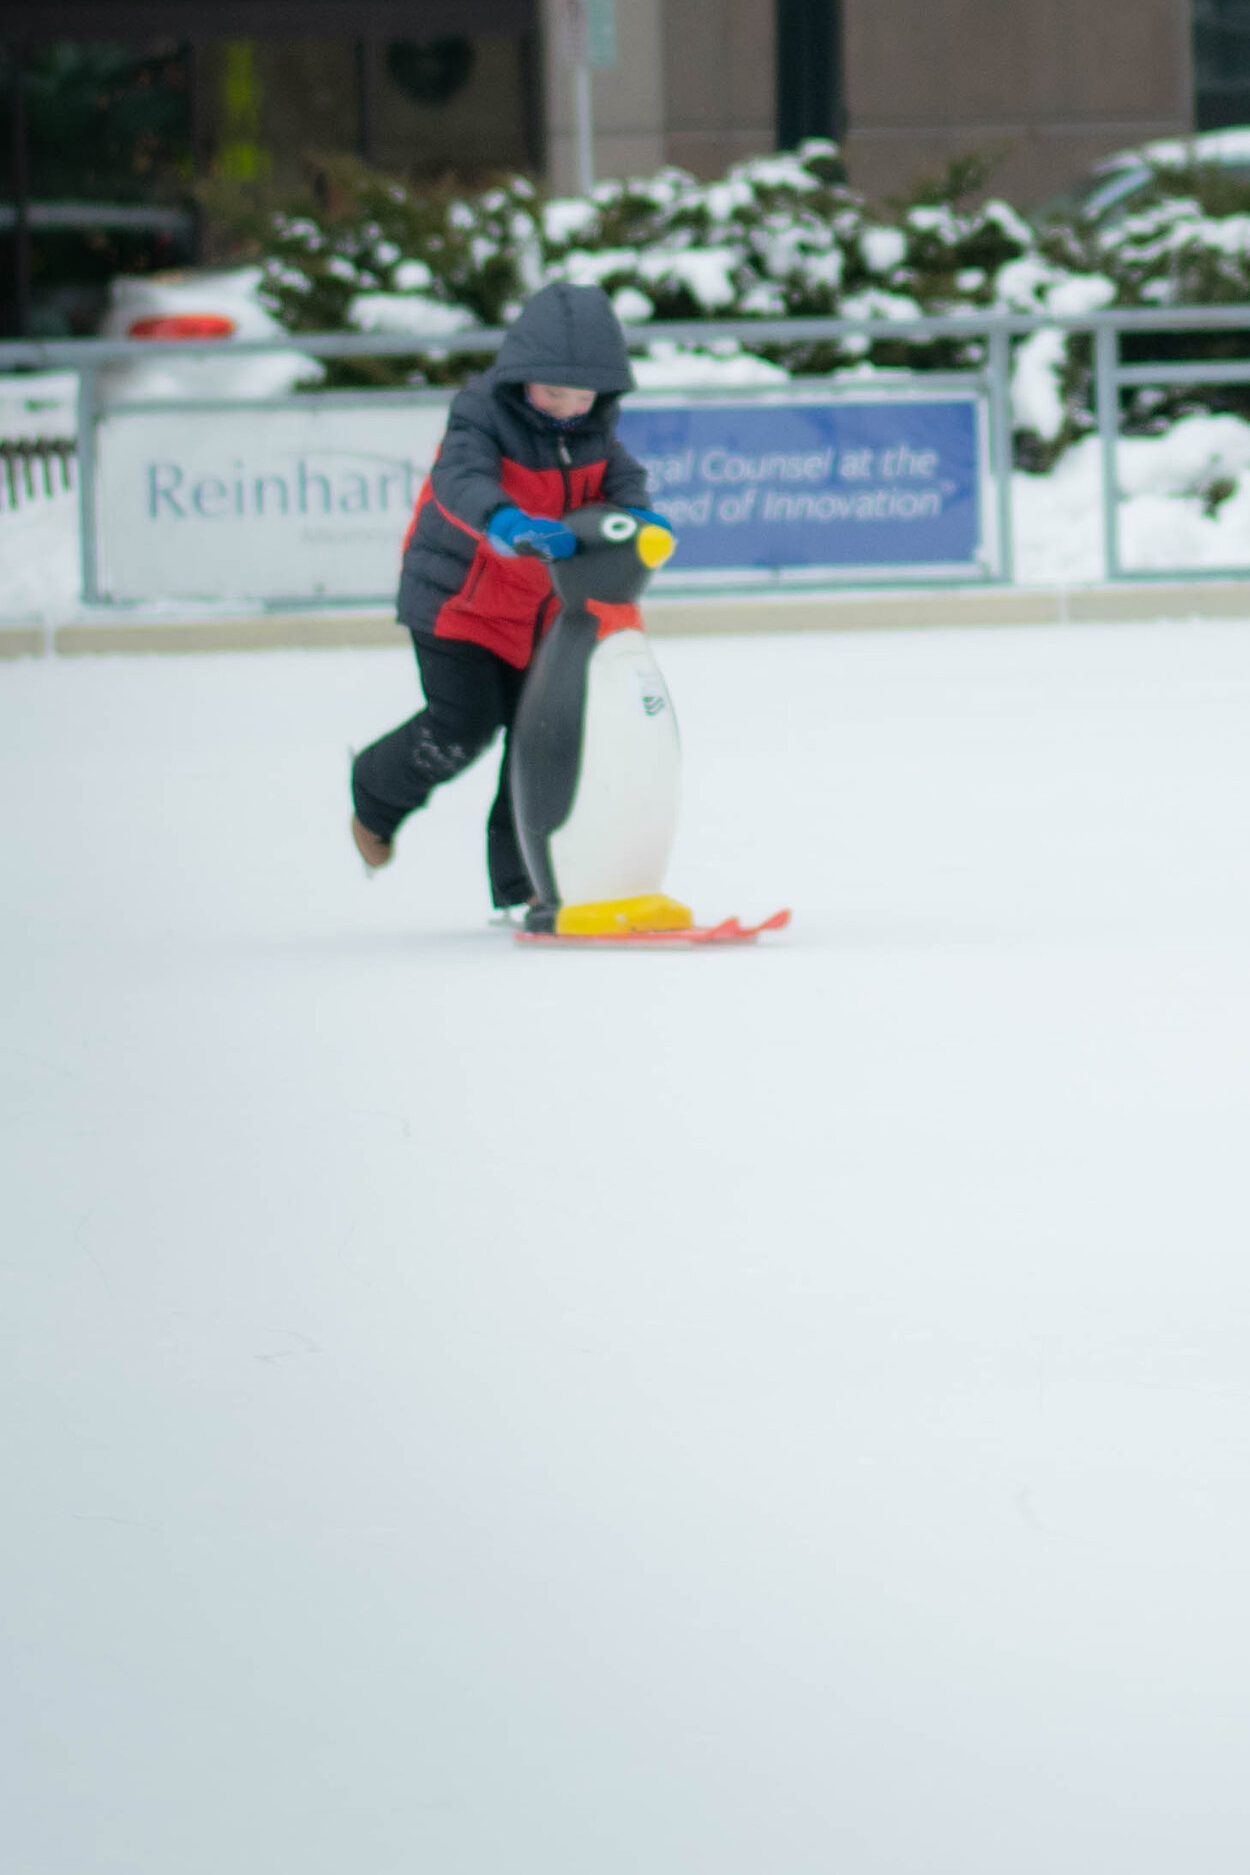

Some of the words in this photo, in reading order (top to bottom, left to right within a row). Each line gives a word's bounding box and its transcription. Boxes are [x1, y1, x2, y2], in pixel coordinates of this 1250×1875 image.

[146, 456, 413, 519] Reinhart
[640, 449, 692, 494] gal
[701, 446, 832, 481] Counsel
[840, 448, 873, 478] at
[882, 445, 938, 477] the
[652, 490, 713, 523] eed
[719, 488, 757, 522] of
